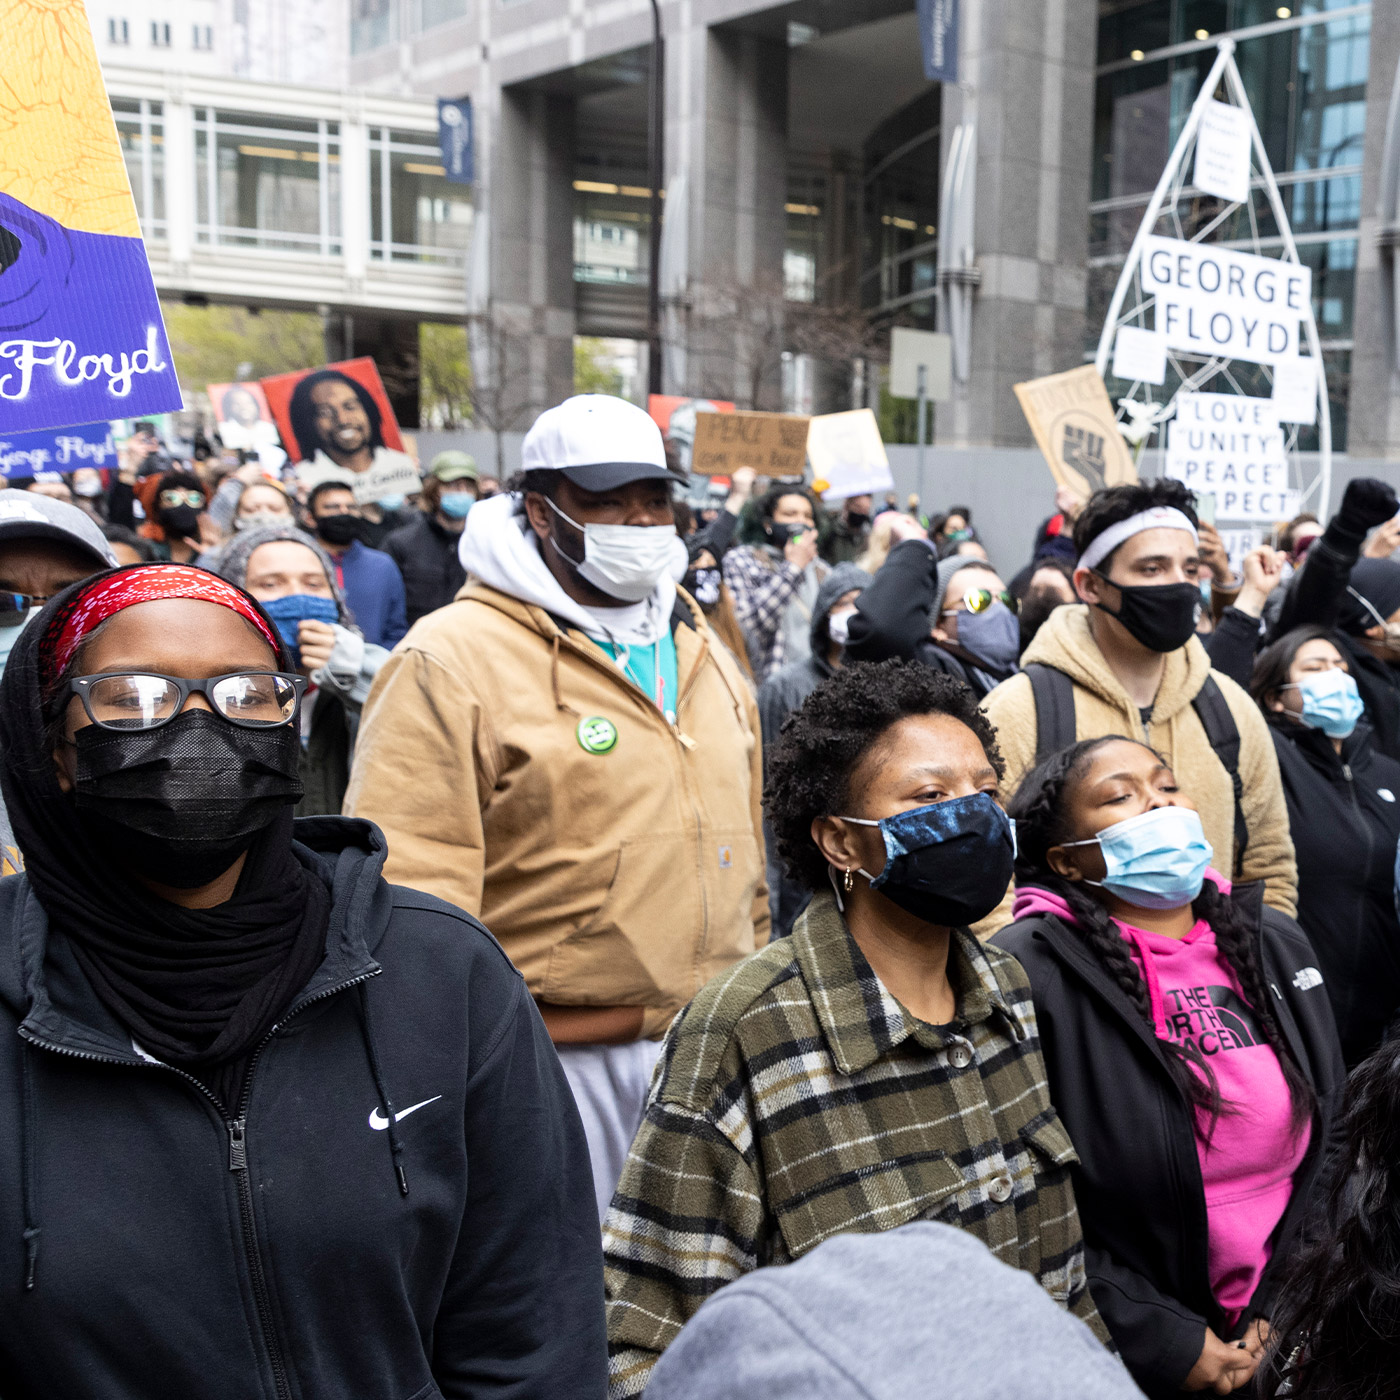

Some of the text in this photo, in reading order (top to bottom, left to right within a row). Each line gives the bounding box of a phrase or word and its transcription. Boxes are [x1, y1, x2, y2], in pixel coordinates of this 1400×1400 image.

[1150, 250, 1302, 310] GEORGE
[1166, 303, 1288, 354] FLOYD
[0, 327, 166, 400] Floyd
[1166, 986, 1211, 1012] THE
